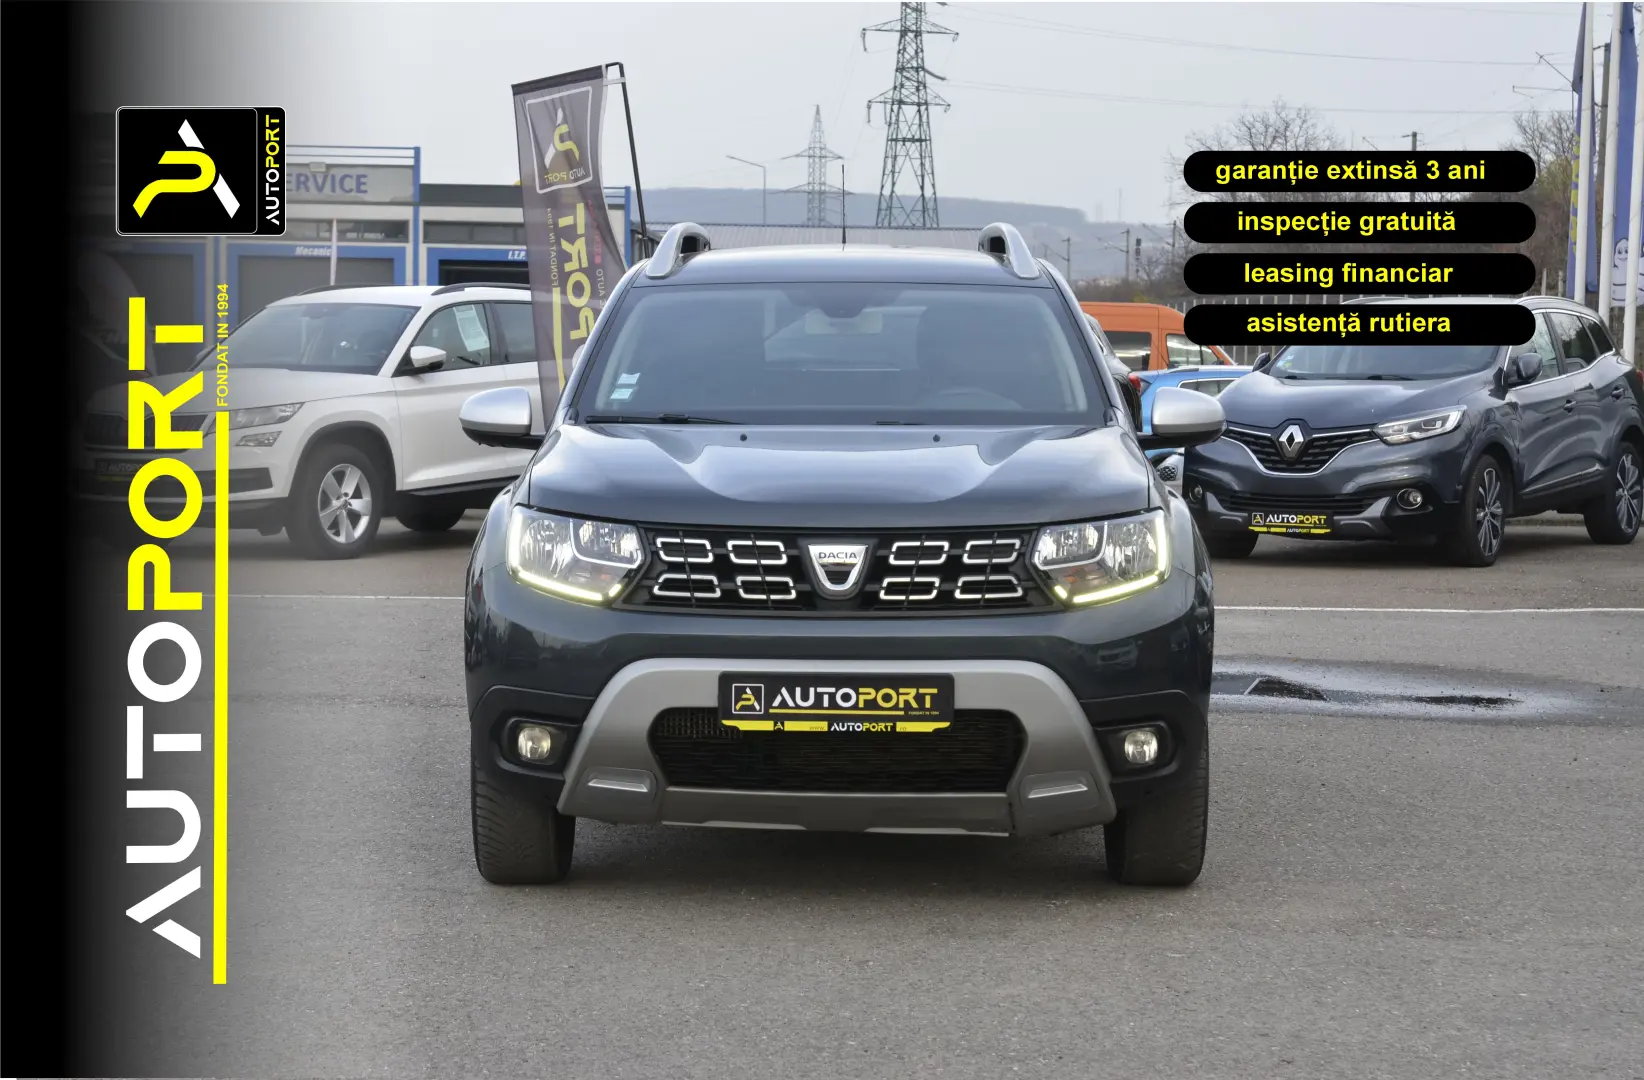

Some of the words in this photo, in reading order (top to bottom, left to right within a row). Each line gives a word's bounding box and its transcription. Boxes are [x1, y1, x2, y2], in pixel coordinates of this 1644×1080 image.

[1265, 514, 1327, 525] AUTOPORT
[772, 687, 938, 709] AUTOPORT
[831, 722, 893, 732] AUTOPORT
